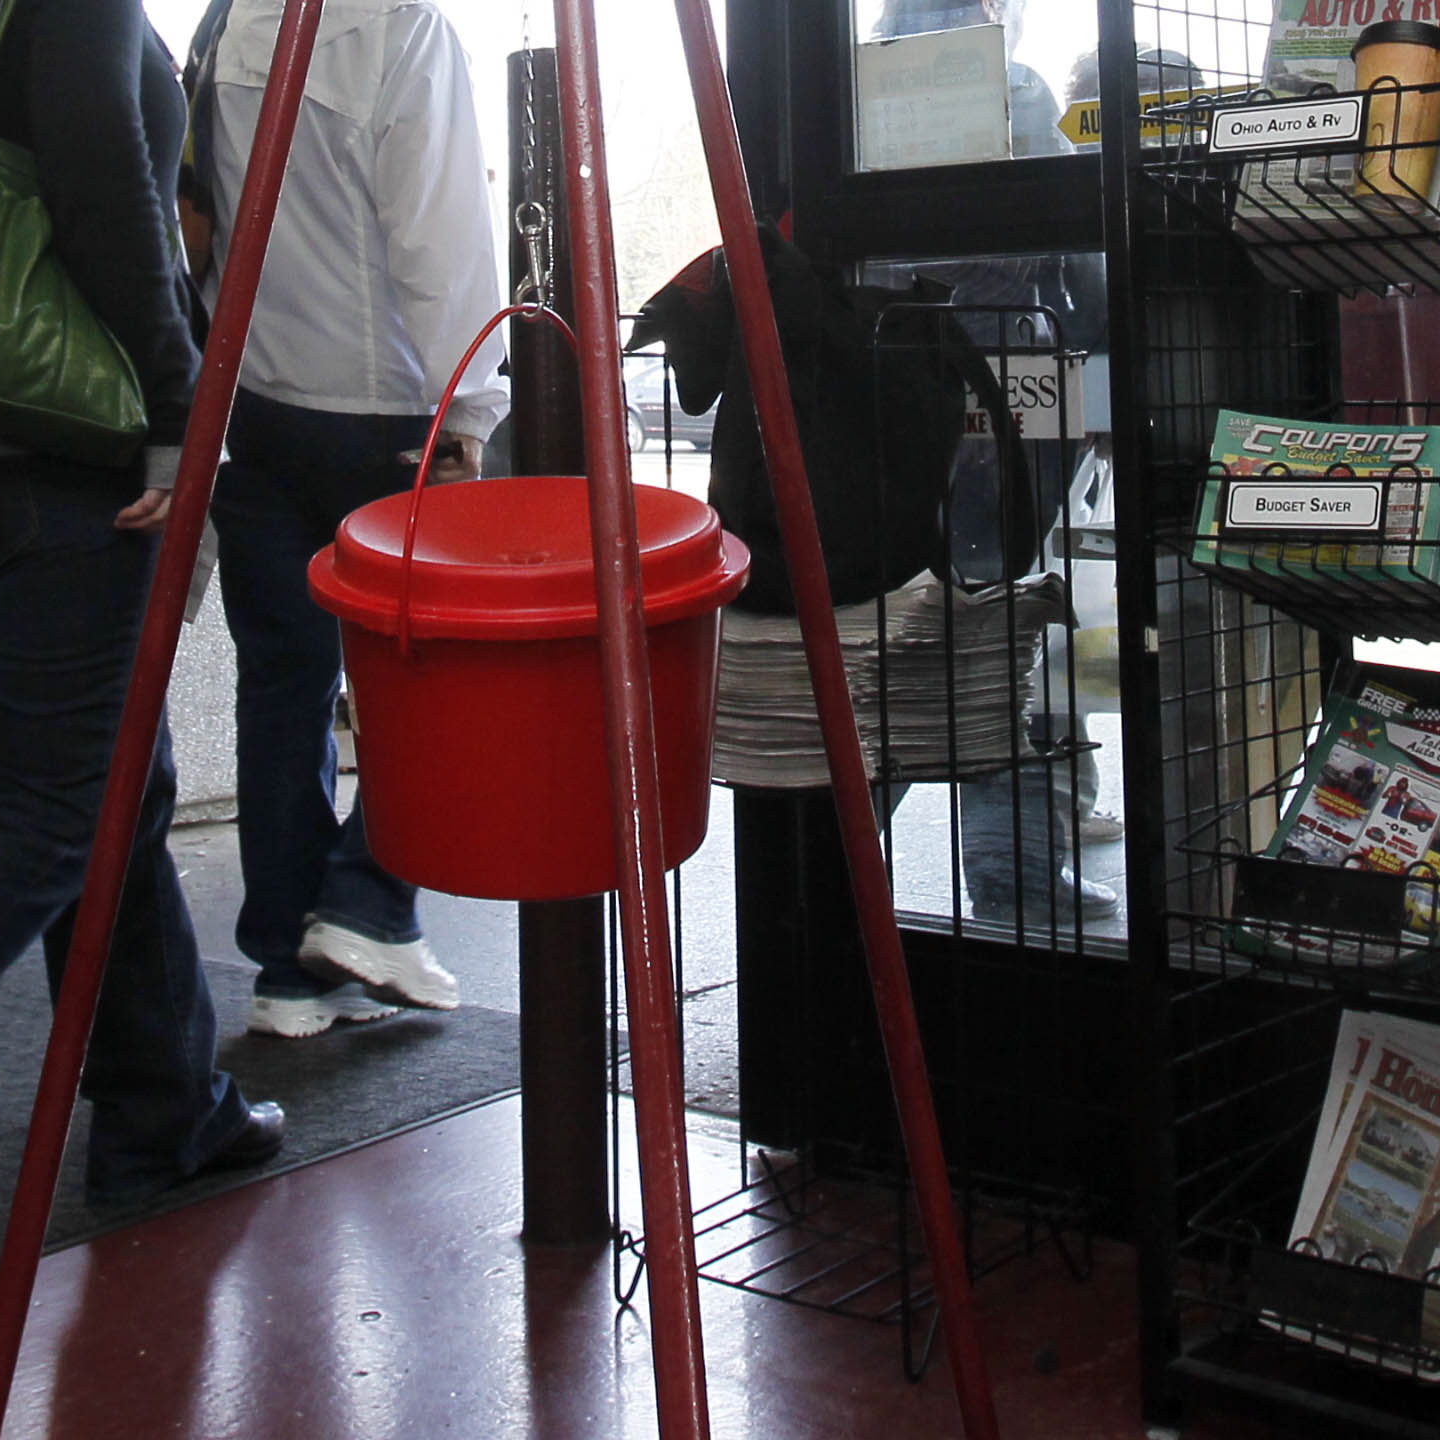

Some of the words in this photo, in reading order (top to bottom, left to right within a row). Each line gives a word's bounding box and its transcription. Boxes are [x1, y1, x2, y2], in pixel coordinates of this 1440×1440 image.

[1306, 115, 1318, 129] &
[1287, 445, 1338, 464] Budget
[1340, 450, 1383, 465] Saver
[1361, 687, 1407, 715] FREE
[1406, 742, 1436, 761] Auto
